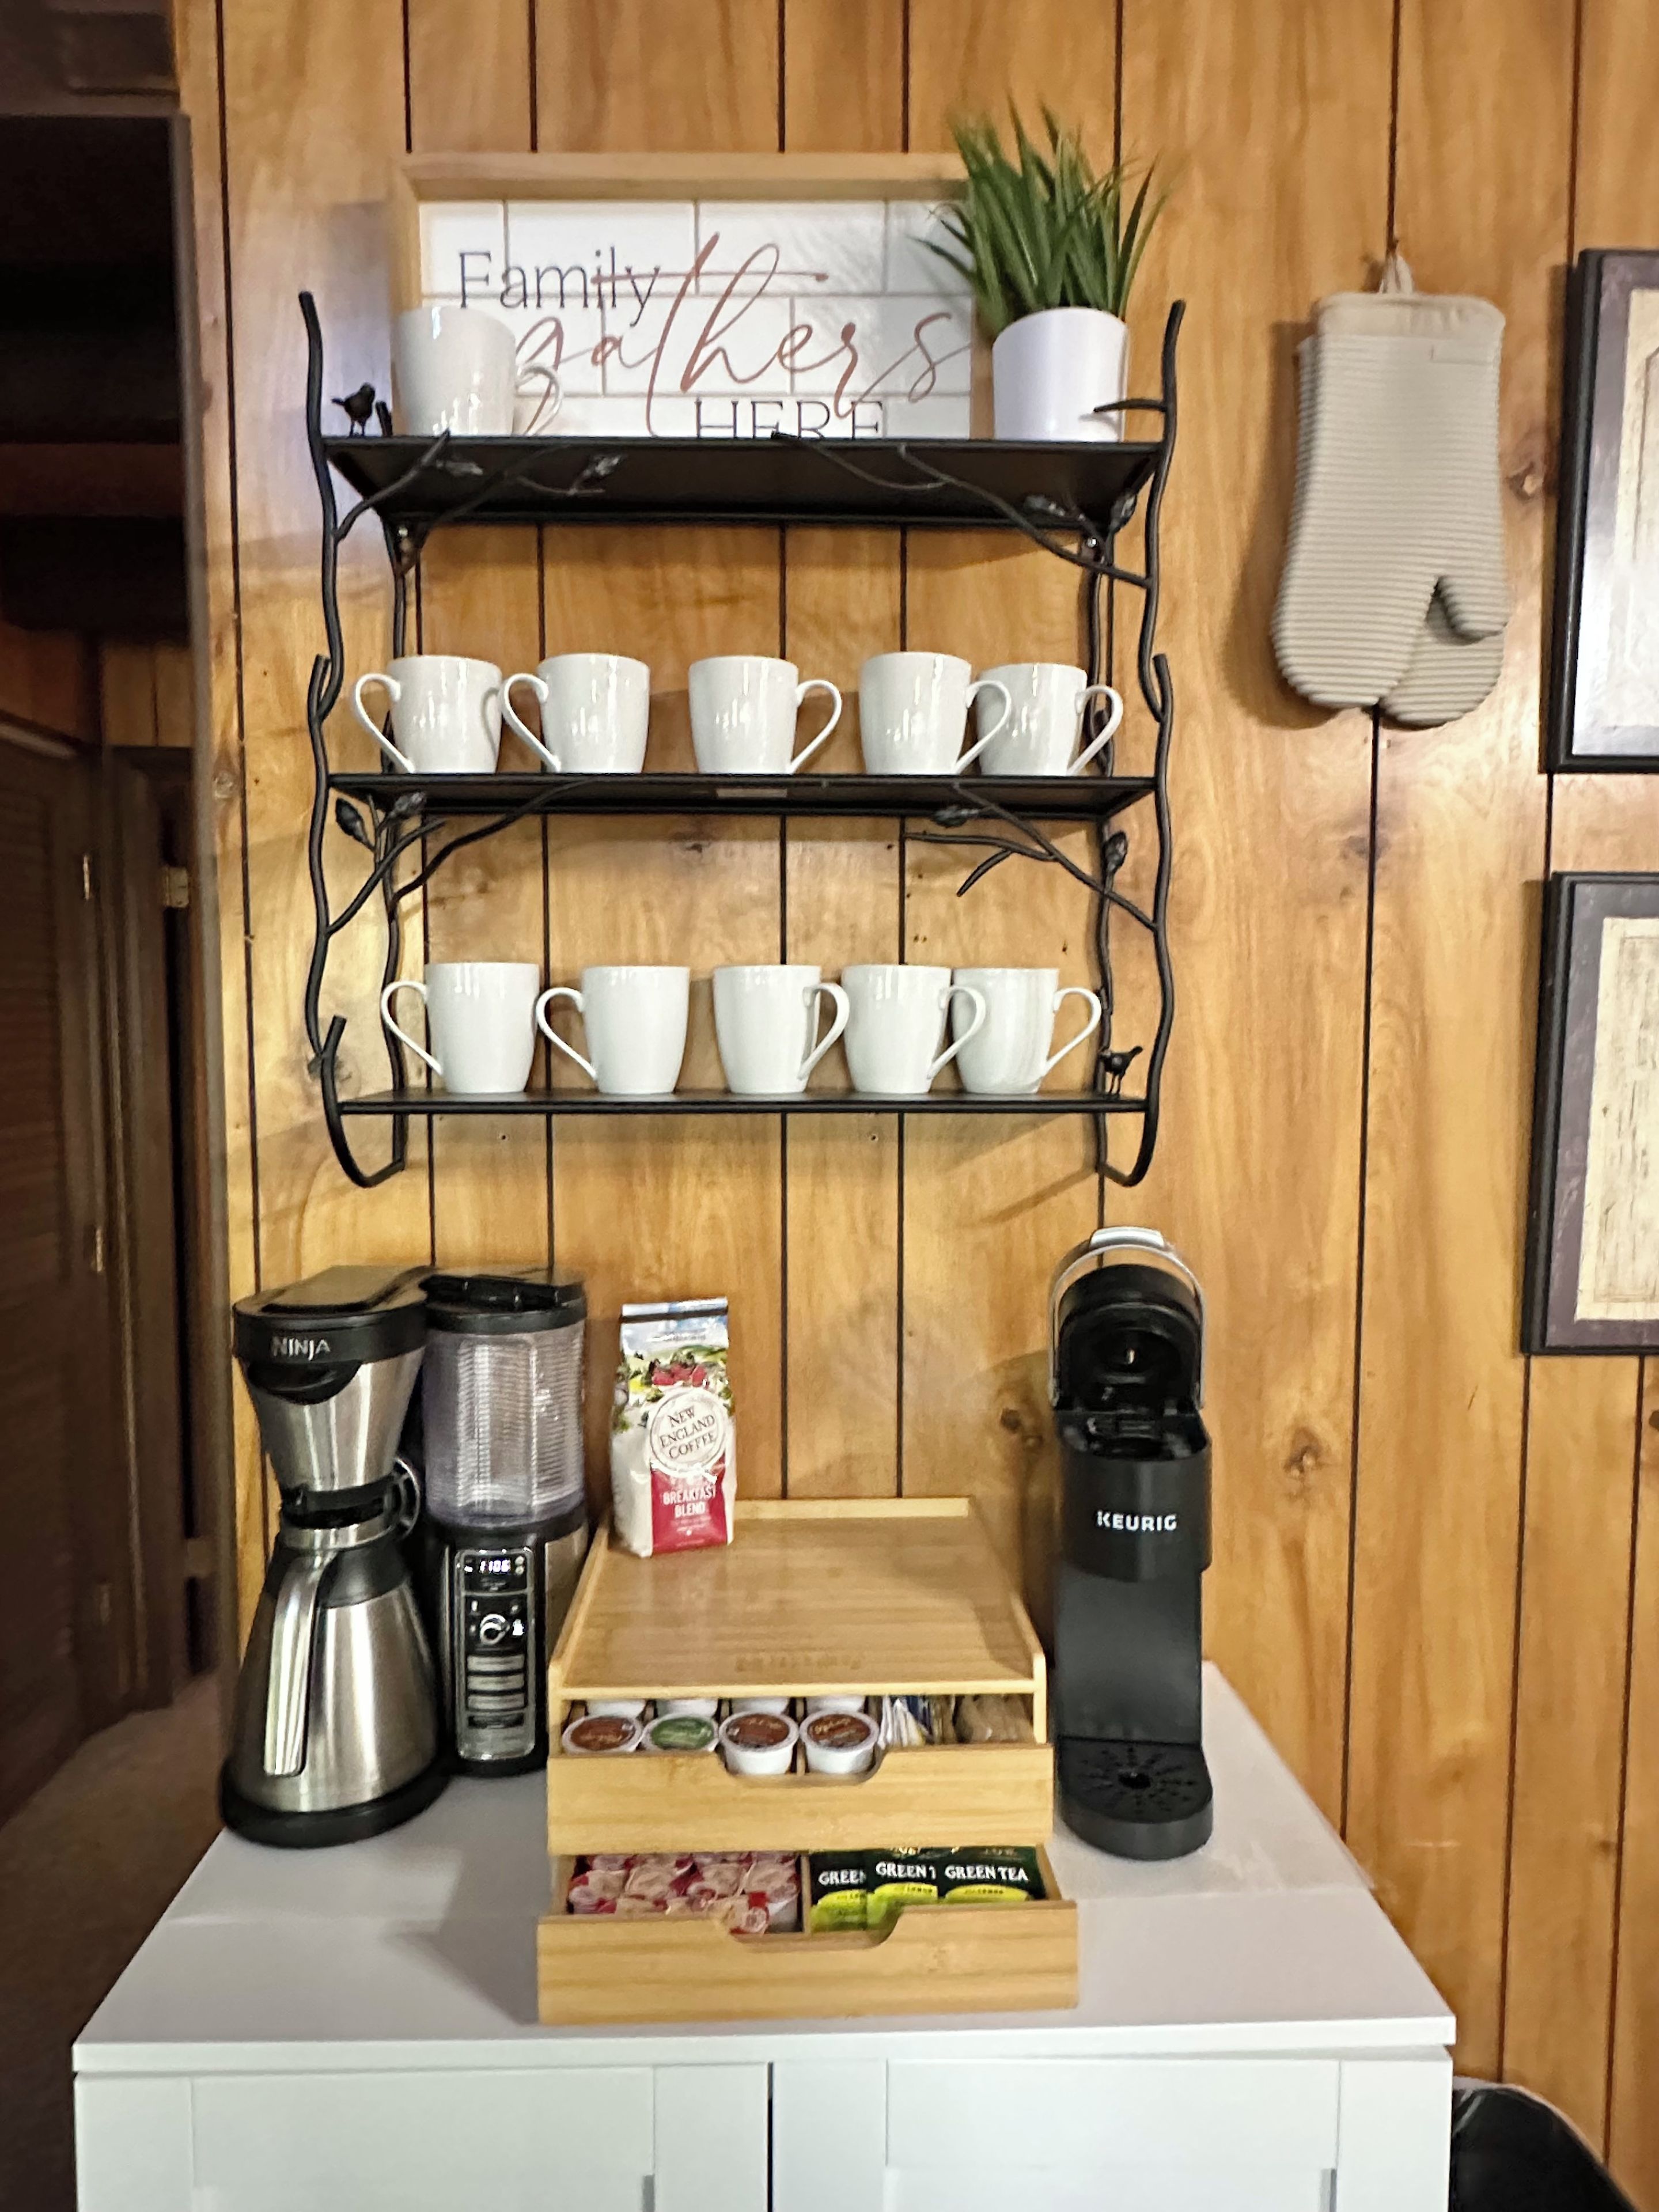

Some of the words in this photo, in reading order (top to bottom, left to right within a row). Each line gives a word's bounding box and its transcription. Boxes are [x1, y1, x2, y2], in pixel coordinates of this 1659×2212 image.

[459, 246, 660, 327] Family
[272, 1336, 331, 1361] NINJA
[668, 1405, 695, 1427] NEW
[659, 1414, 715, 1448] ENGLAND
[668, 1431, 716, 1459] COFFEE
[662, 1484, 717, 1506] BREAKFAST
[675, 1501, 707, 1519] BLEND
[1097, 1510, 1177, 1532] KEURIG
[876, 1861, 927, 1878] GREEN
[945, 1863, 997, 1880] GREEN
[997, 1866, 1029, 1881] TEA
